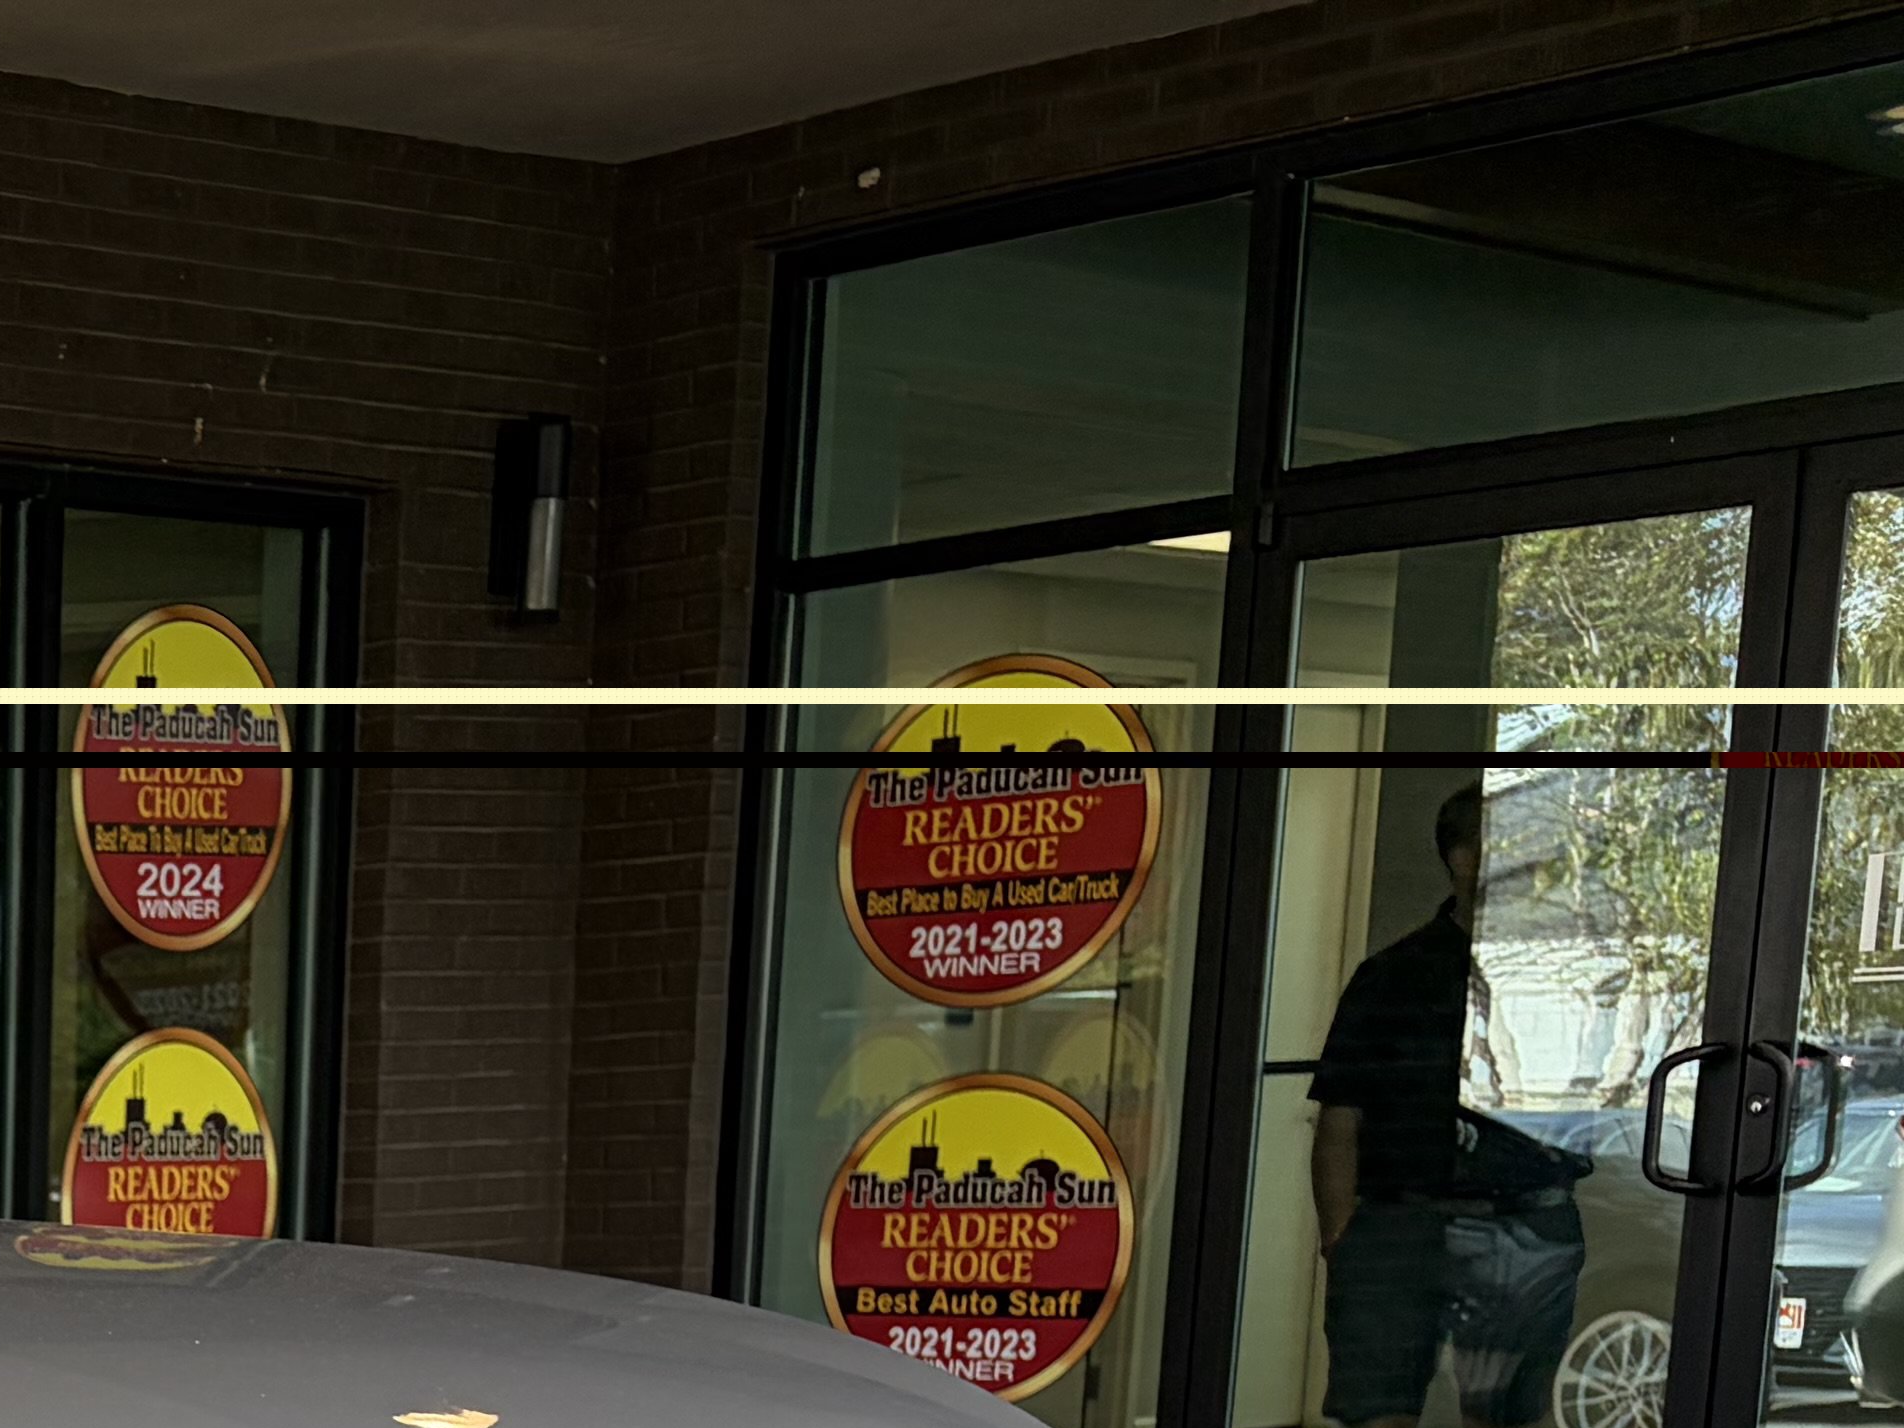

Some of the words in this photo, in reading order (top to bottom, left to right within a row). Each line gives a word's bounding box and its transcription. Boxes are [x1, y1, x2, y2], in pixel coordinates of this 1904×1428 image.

[91, 704, 132, 741] The
[139, 704, 233, 744] Paducah
[238, 708, 279, 746] Sun
[137, 788, 228, 820] CHOICE
[866, 769, 926, 807] The
[933, 766, 1070, 799] Paducah
[95, 824, 118, 852] Best
[120, 825, 148, 853] Place
[163, 826, 182, 857] Buy
[184, 827, 193, 853] A
[194, 827, 219, 853] Used
[927, 837, 1059, 880] CHOICE
[137, 862, 224, 898] 2024
[866, 888, 898, 918] Best
[901, 886, 941, 914] Place
[943, 886, 958, 911] to
[961, 882, 990, 915] Buy
[992, 881, 1004, 907] A
[1007, 877, 1045, 906] Used
[137, 899, 221, 920] WINNER
[909, 917, 1064, 959] 2021-2023
[923, 951, 1041, 978] WINNER
[81, 1126, 124, 1161] The
[128, 1121, 220, 1161] Paducah
[224, 1127, 264, 1160] Sun
[847, 1172, 904, 1208] The
[911, 1169, 1047, 1208] Paducah
[1053, 1171, 1118, 1208] Sun
[126, 1202, 215, 1233] CHOICE
[905, 1251, 1034, 1283] CHOICE
[856, 1288, 920, 1314] Best
[929, 1290, 997, 1316] Auto
[1008, 1289, 1083, 1317] Staff
[888, 1325, 1036, 1361] 2021-2023
